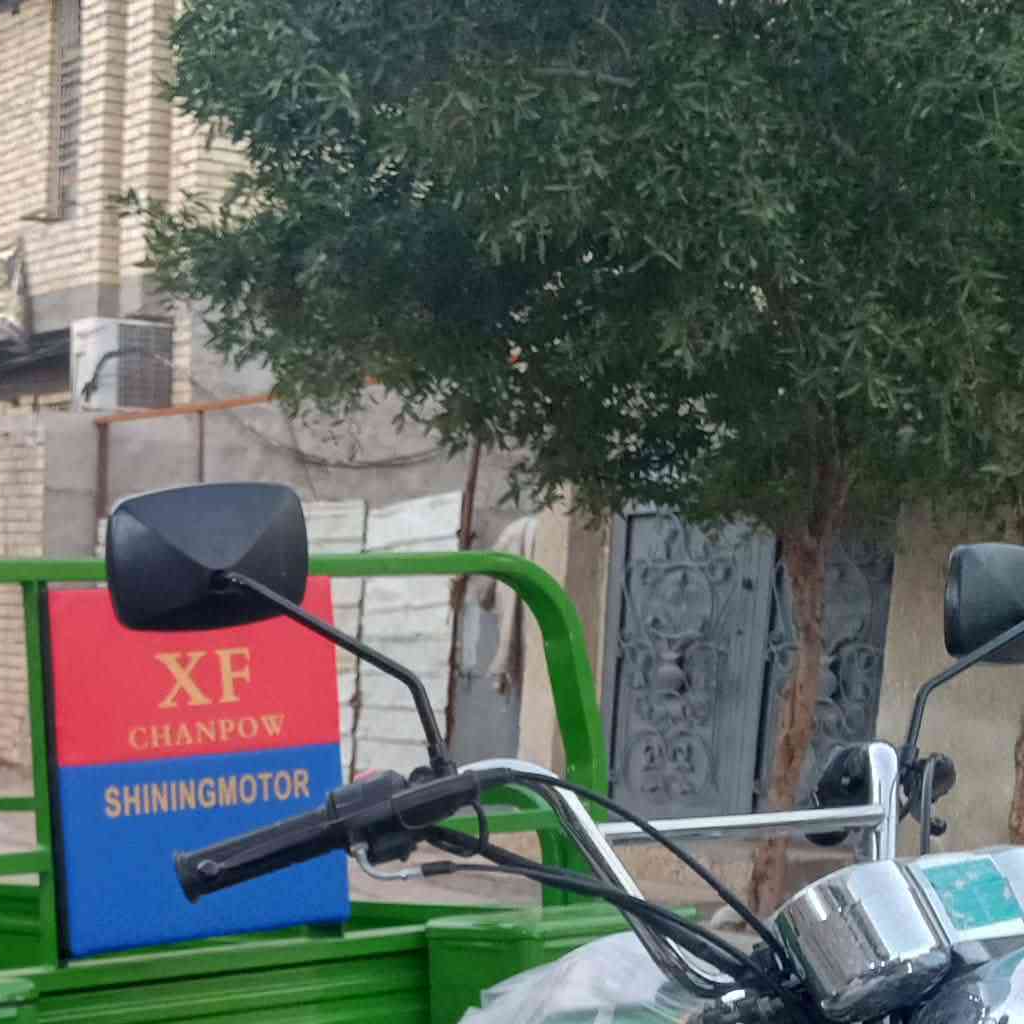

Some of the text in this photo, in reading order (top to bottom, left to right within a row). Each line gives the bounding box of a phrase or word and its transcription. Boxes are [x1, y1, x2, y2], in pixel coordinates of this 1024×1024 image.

[154, 647, 252, 709] XF
[128, 713, 287, 751] CHANPOW
[104, 768, 310, 818] SHININGMOTOR
